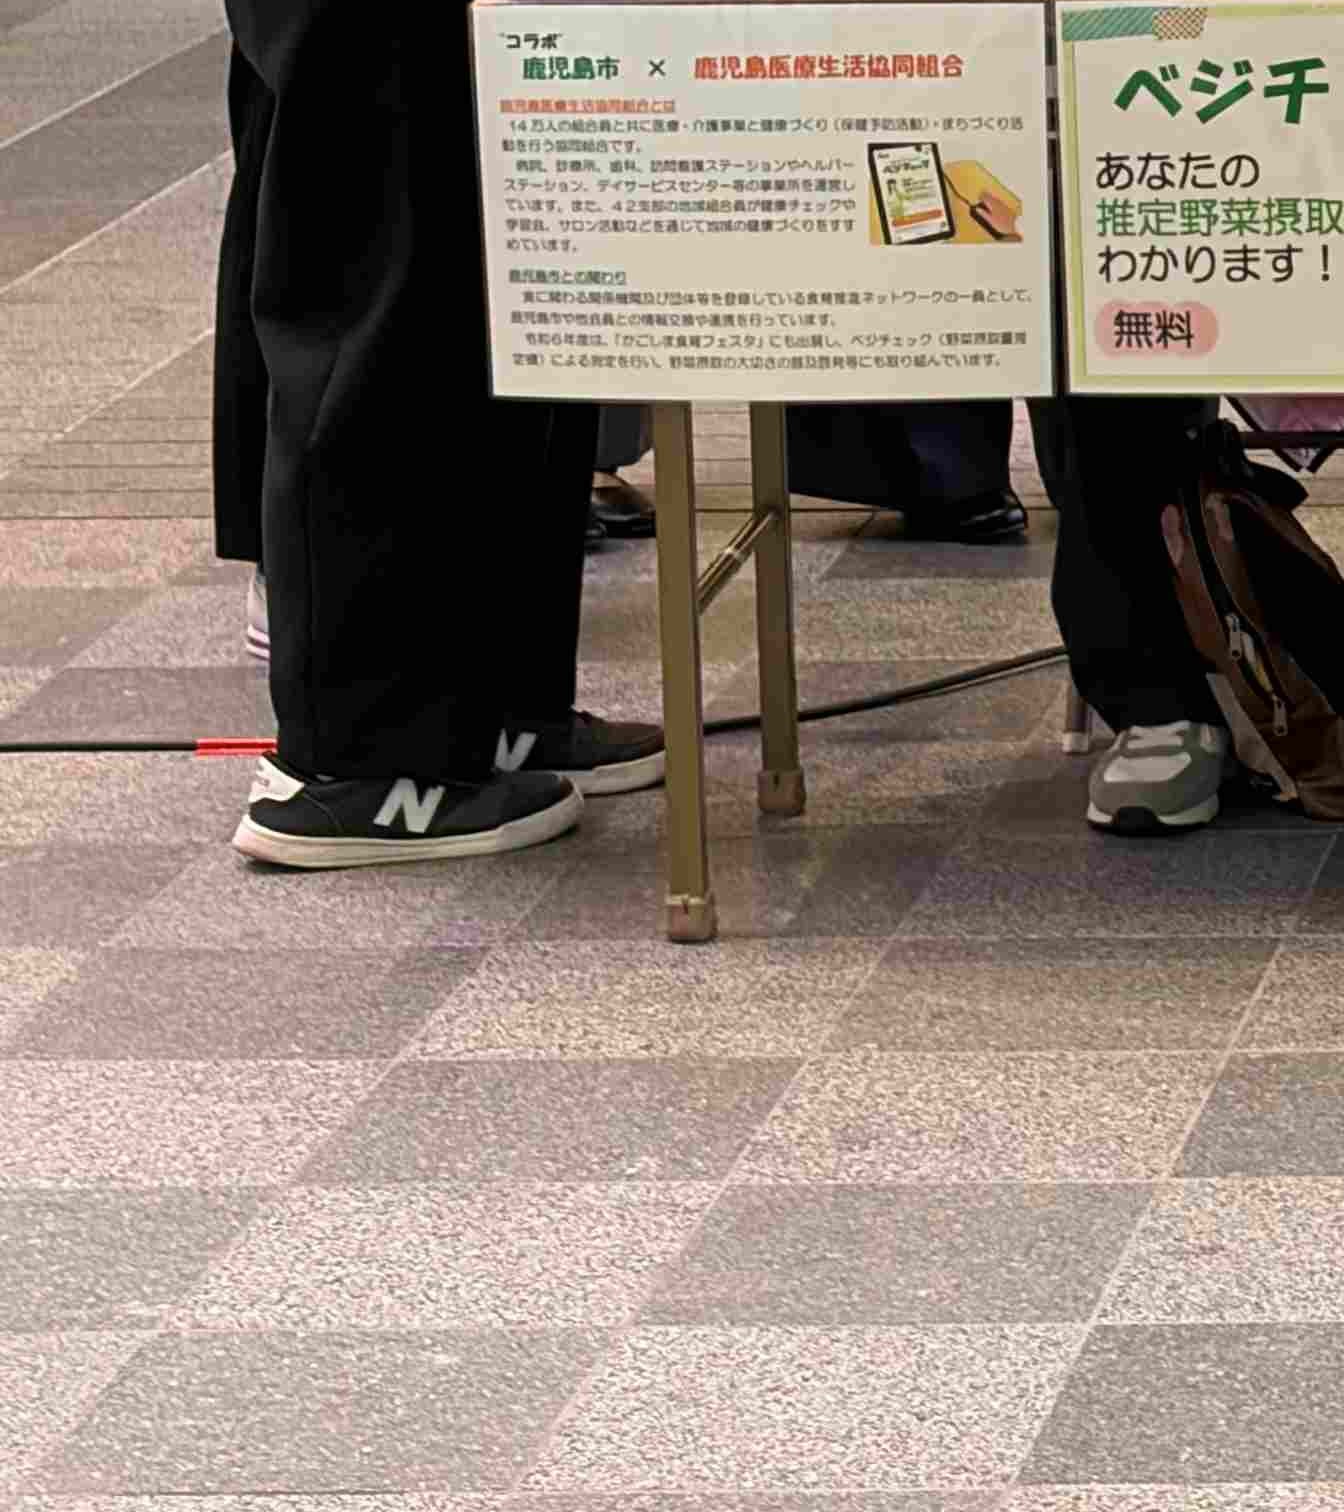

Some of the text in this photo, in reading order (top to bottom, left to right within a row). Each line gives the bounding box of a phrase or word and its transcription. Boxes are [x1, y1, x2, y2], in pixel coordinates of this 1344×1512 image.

[522, 55, 621, 80] 鹿児島市
[693, 54, 965, 80] 鹿児島医療生活協同組合
[1095, 151, 1260, 190] あなたの
[1097, 243, 1332, 284] わかります！
[1113, 310, 1195, 349] 無料
[373, 777, 446, 834] N
